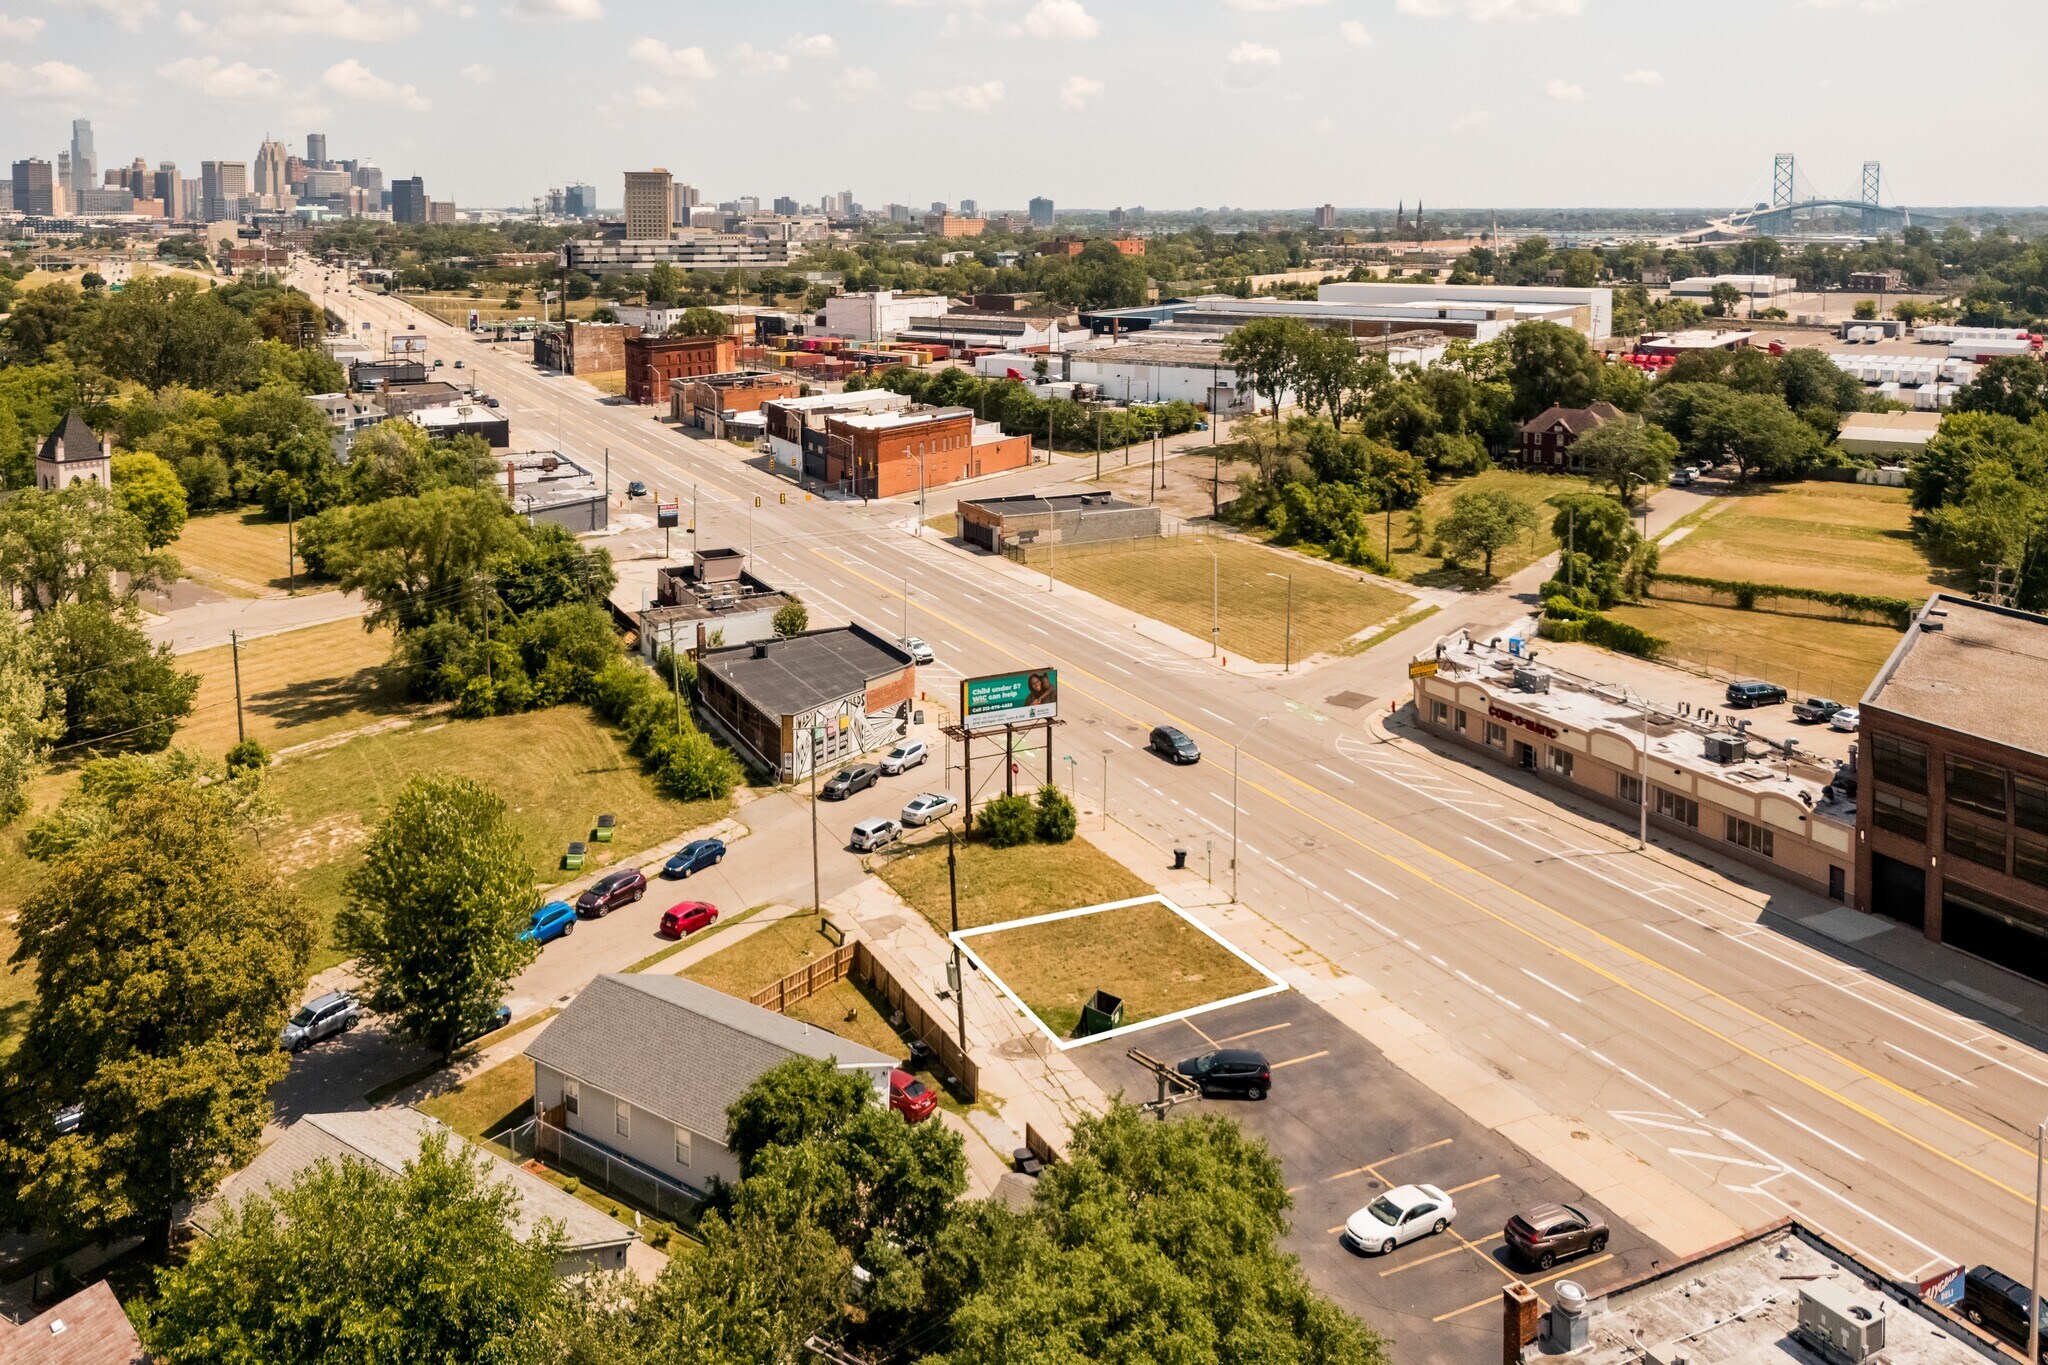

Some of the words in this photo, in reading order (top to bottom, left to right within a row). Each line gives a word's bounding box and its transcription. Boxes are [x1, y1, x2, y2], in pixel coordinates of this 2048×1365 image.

[972, 687, 990, 695] Child
[991, 685, 1012, 693] under
[972, 695, 987, 703] WIC
[1002, 690, 1018, 698] help
[1941, 1288, 1954, 1301] DELI
